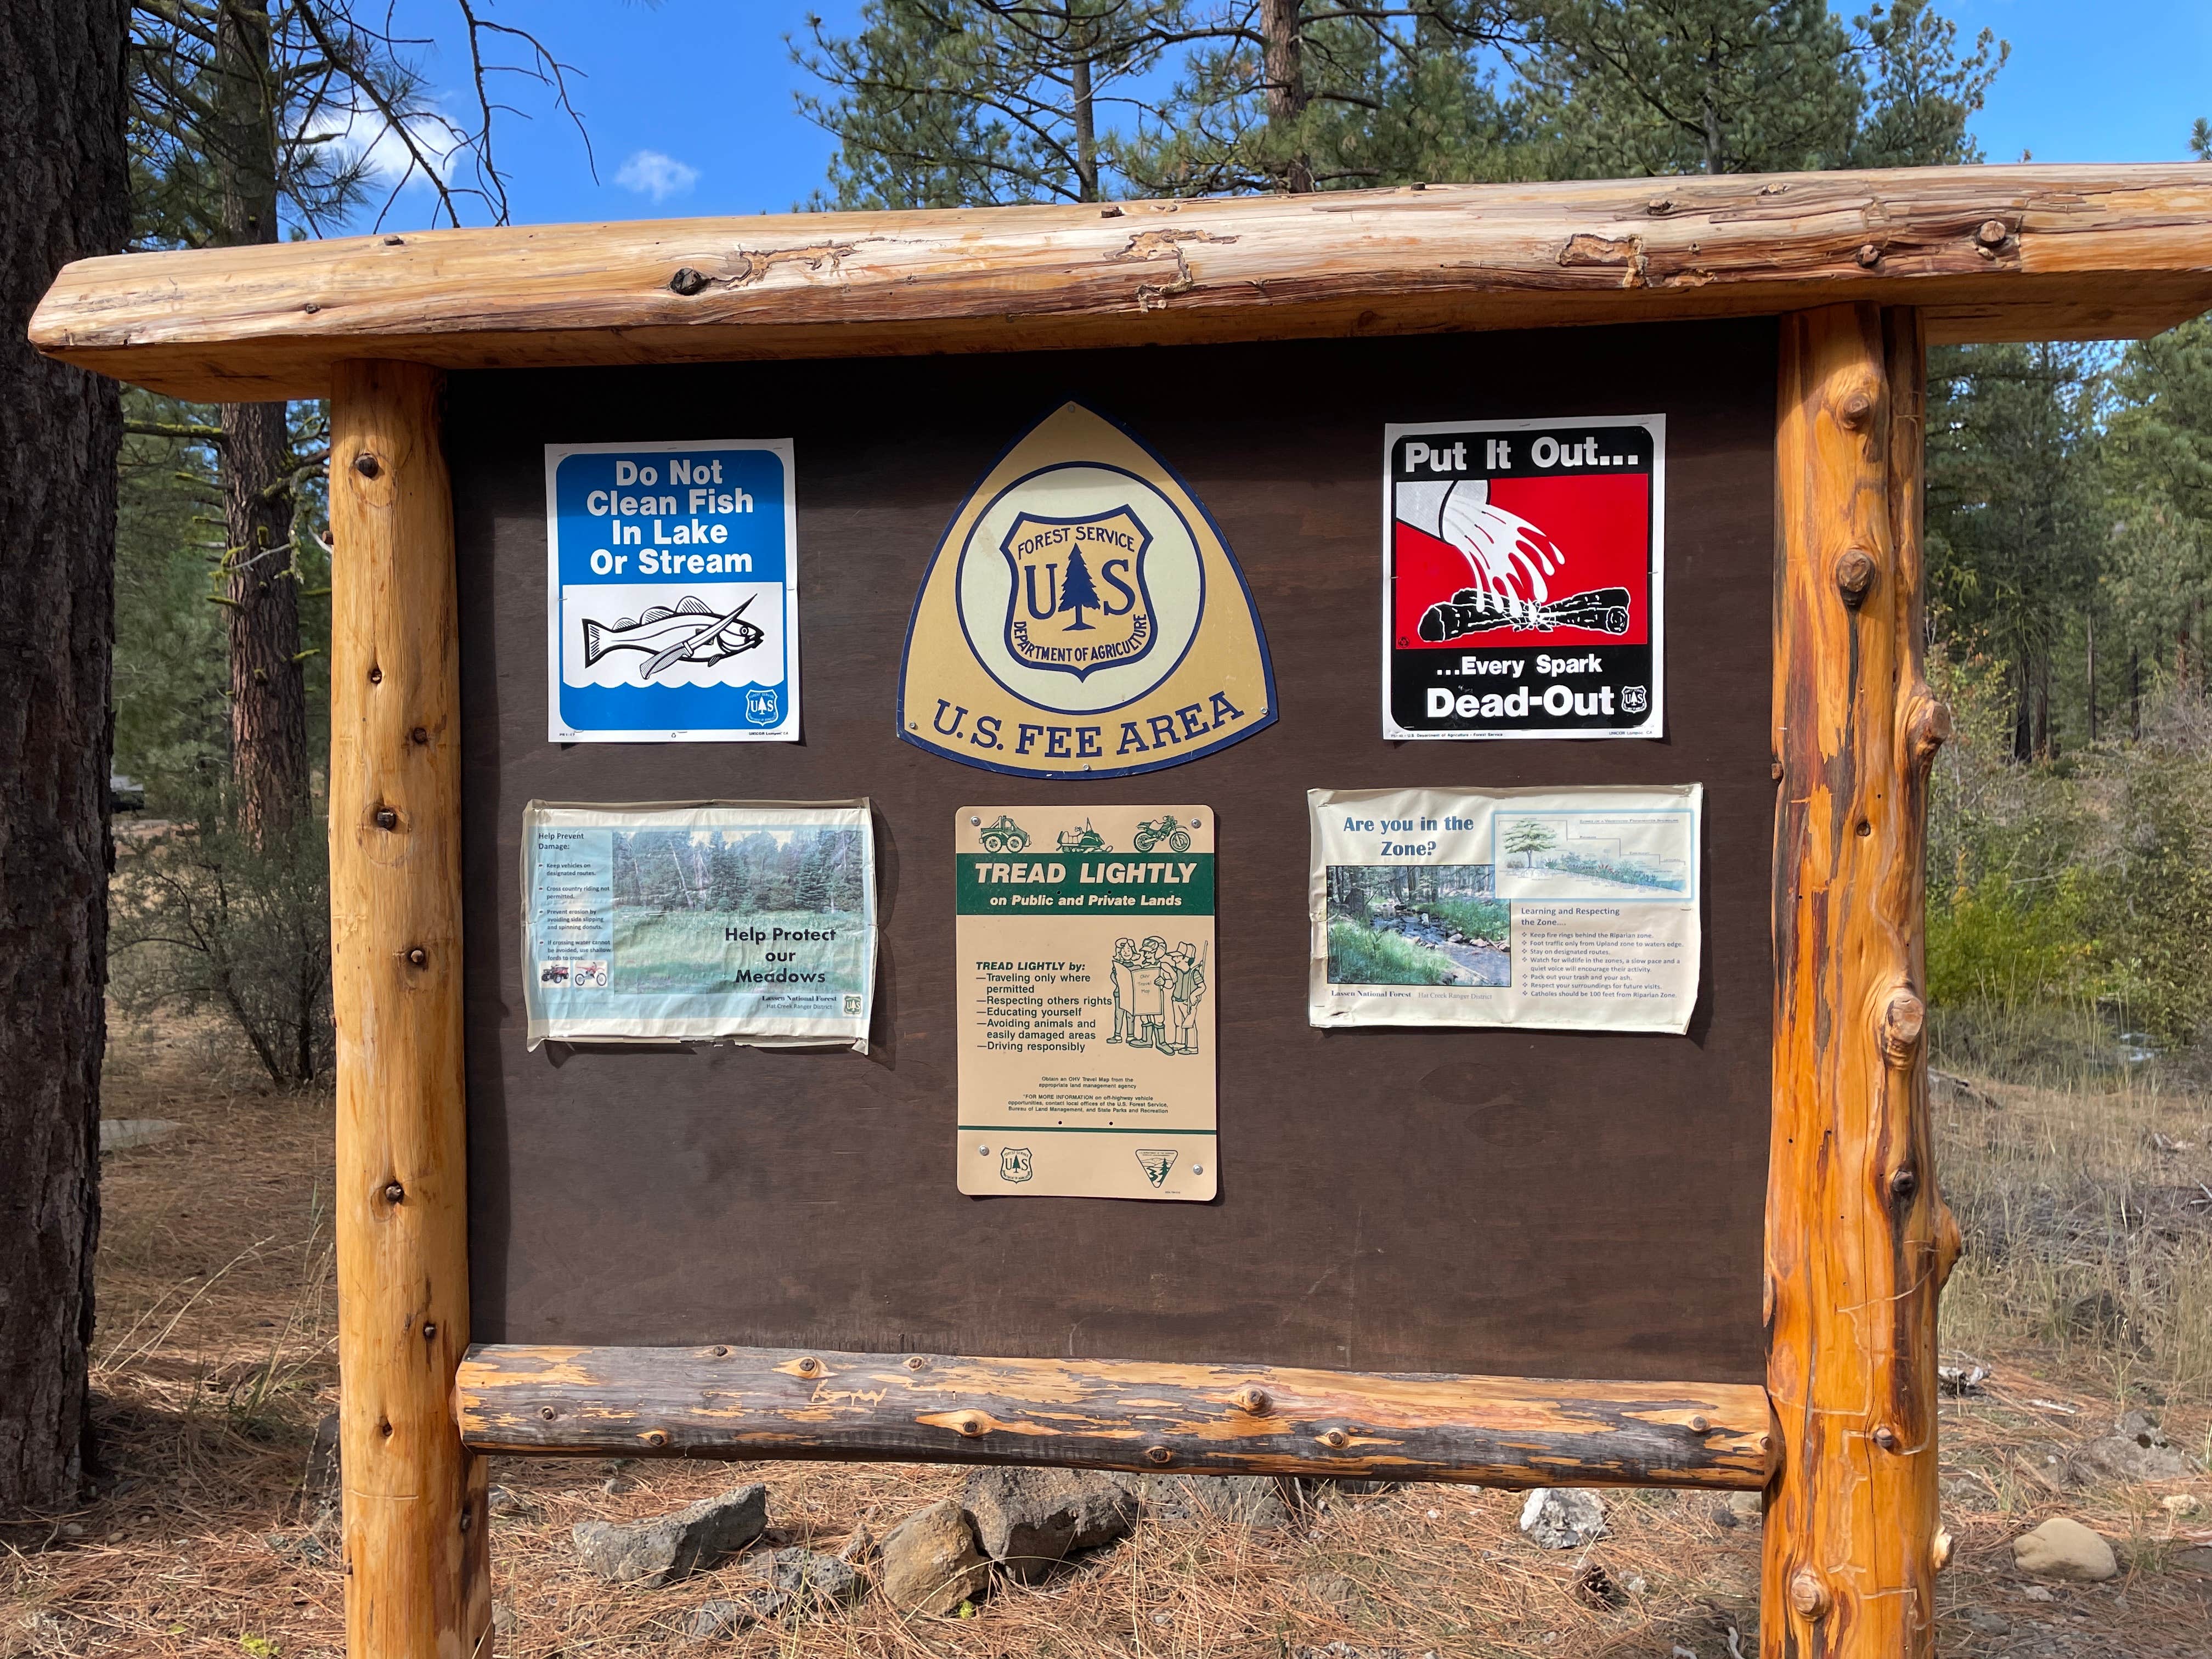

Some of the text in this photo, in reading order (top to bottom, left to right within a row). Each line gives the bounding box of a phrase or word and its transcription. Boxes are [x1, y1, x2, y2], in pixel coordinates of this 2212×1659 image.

[1405, 437, 1639, 473] Put It Out...
[616, 458, 723, 486] Do Not
[586, 487, 753, 517] Clean Fish
[612, 518, 727, 545] In Lake
[1018, 526, 1135, 560] FOREST SERVICE
[590, 549, 752, 575] Or Stream
[1014, 614, 1147, 662] DEPARTMENT OF AGRICULTURE
[1437, 653, 1602, 679] ...Every Spark
[1427, 685, 1614, 718] Dead-Out
[933, 691, 1244, 758] U.S. FEE AREA
[1344, 816, 1474, 834] Are you in the
[1380, 841, 1436, 855] Zone?
[975, 862, 1197, 884] TREAD LIGHTLY
[990, 894, 1182, 906] on Public and Private Lands
[1521, 907, 1556, 916] Learning
[1576, 907, 1620, 916] Respecting
[726, 927, 837, 945] Help Protect
[765, 952, 795, 962] our
[976, 962, 1085, 972] TREAD LIGHTLY by:
[736, 968, 825, 983] Meadows
[1034, 974, 1056, 984] only
[986, 984, 1034, 995] permitted
[1047, 996, 1079, 1005] others
[1084, 996, 1112, 1007] rights
[1041, 1007, 1081, 1018] yourself
[1034, 1019, 1073, 1028] animals
[1077, 1019, 1095, 1028] and
[986, 1030, 1015, 1041] easily
[1018, 1030, 1064, 1041] damaged
[1027, 1041, 1085, 1053] responsibly
